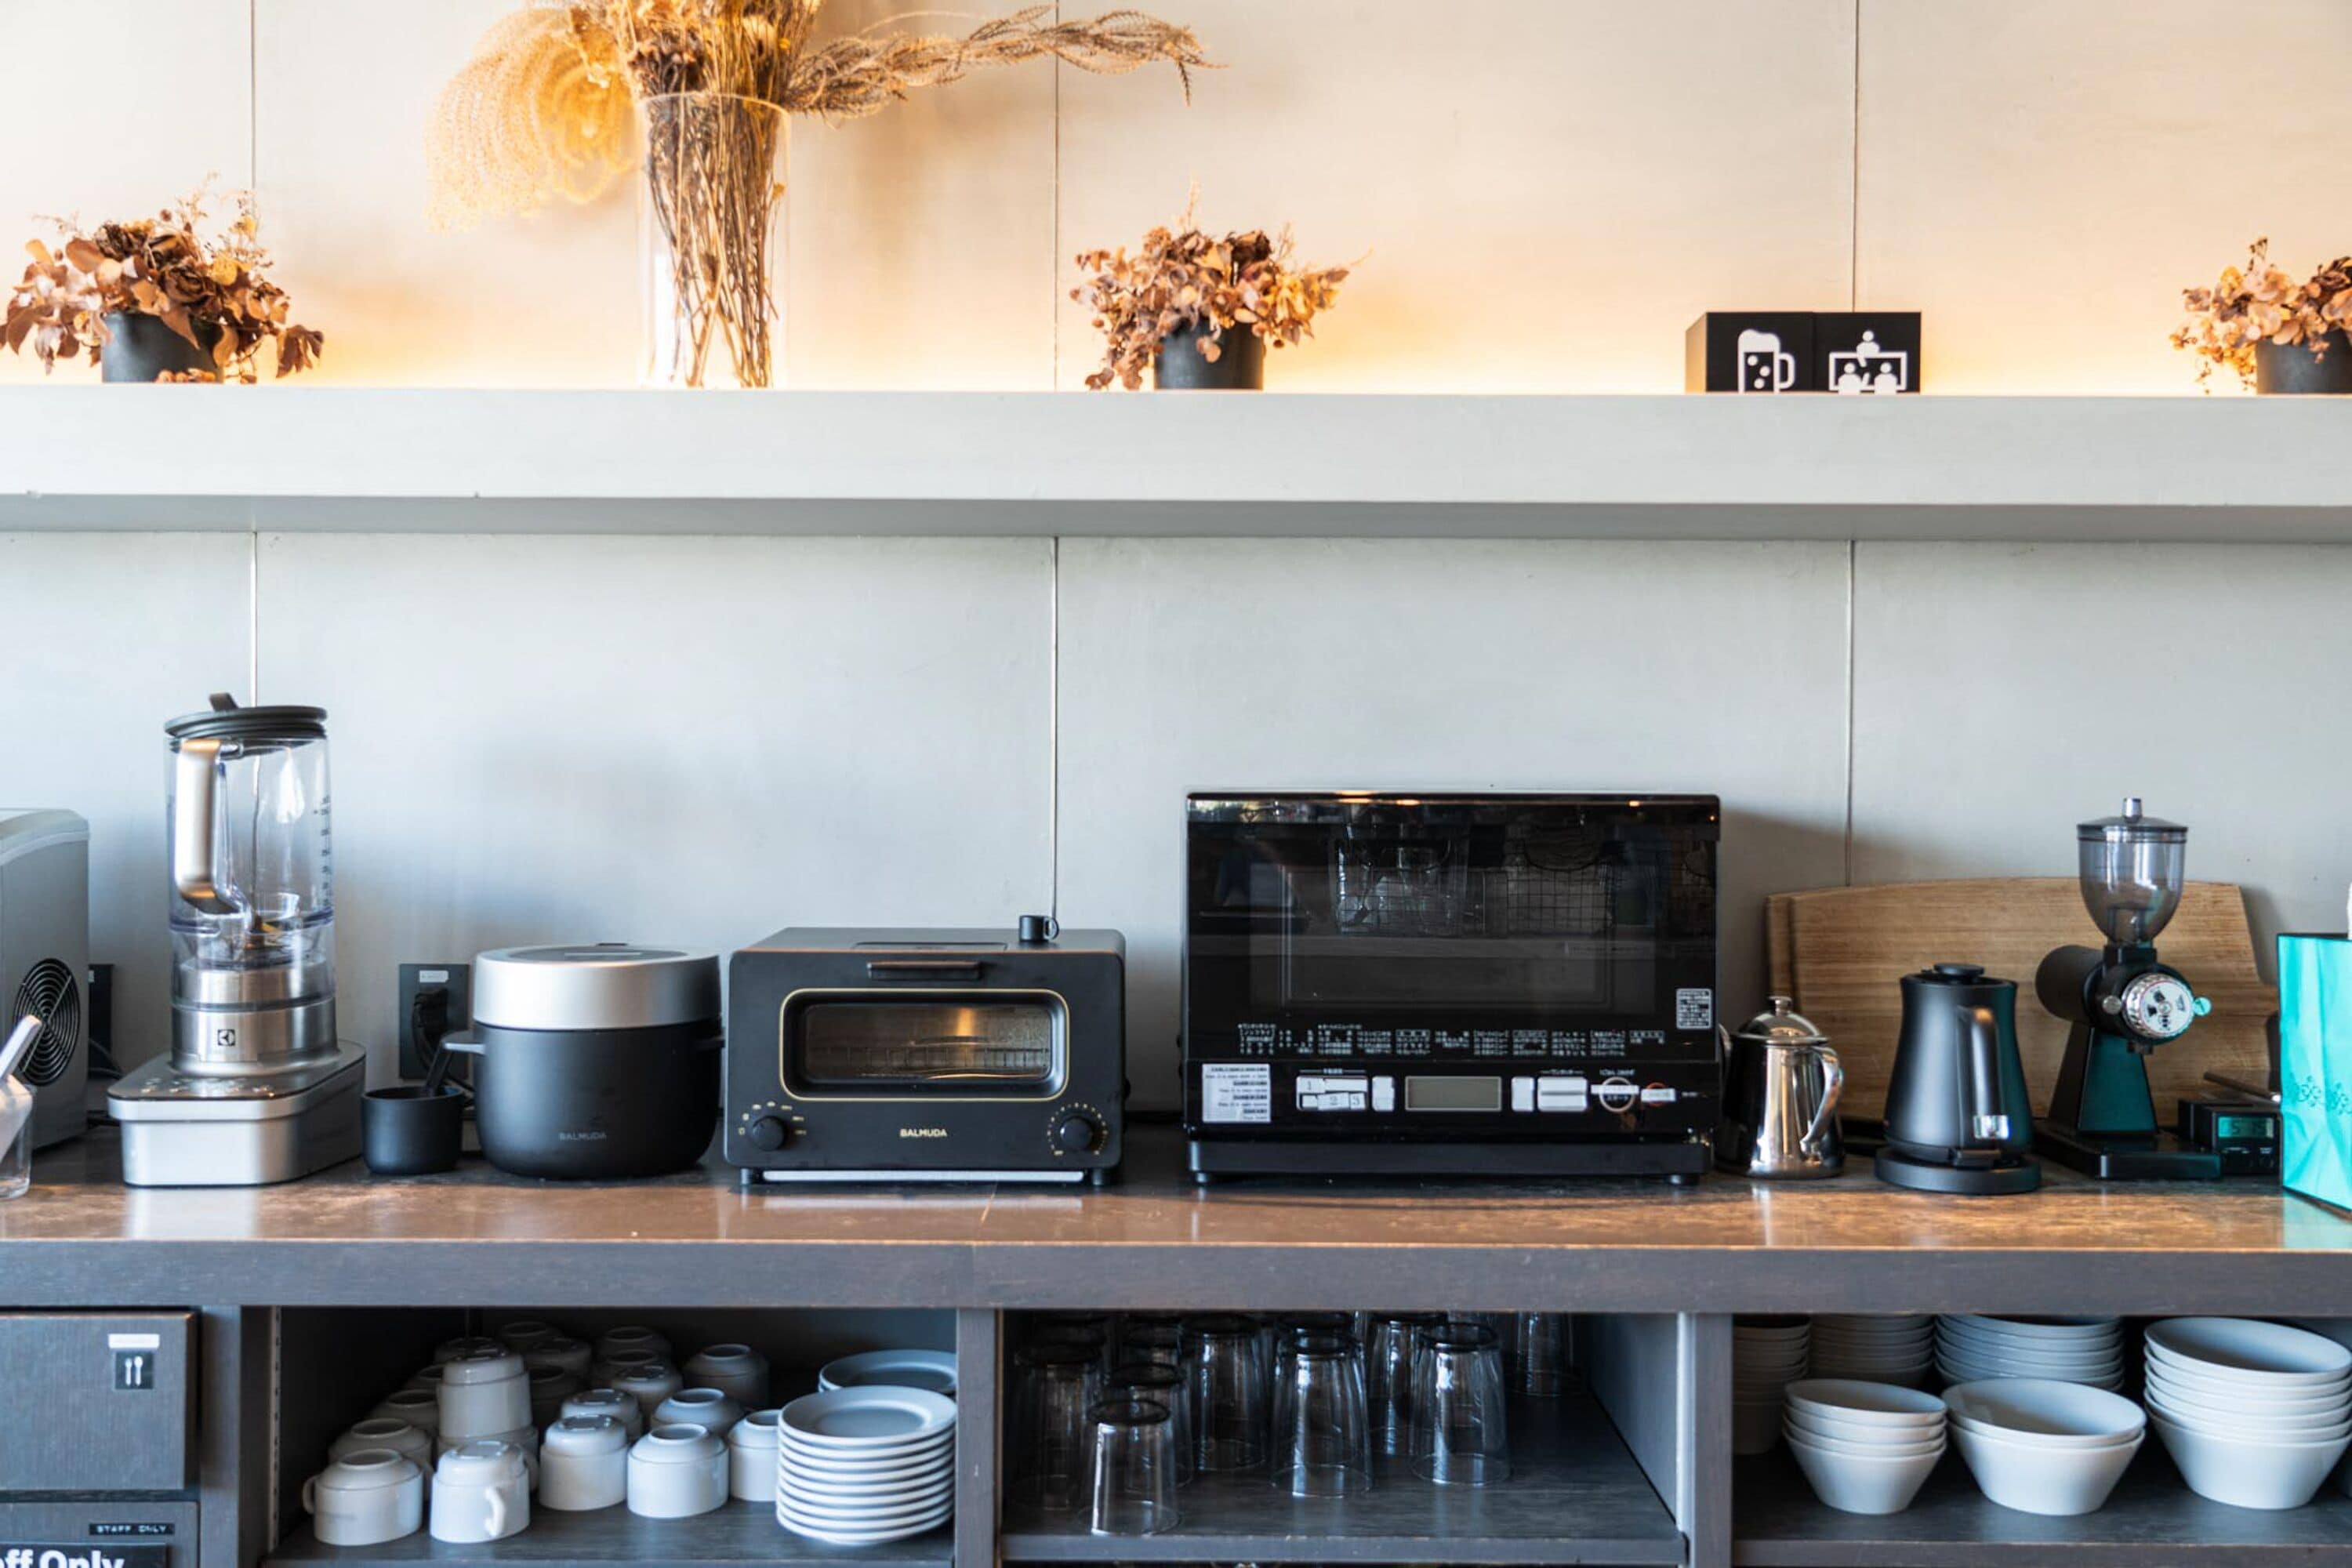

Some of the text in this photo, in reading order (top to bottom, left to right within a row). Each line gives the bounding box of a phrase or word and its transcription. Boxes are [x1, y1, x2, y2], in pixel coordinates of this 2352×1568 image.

[559, 1131, 607, 1141] BALMUDA
[900, 1128, 947, 1137] BALMUDA
[97, 1524, 132, 1533] STAFF
[0, 1548, 34, 1568] ff
